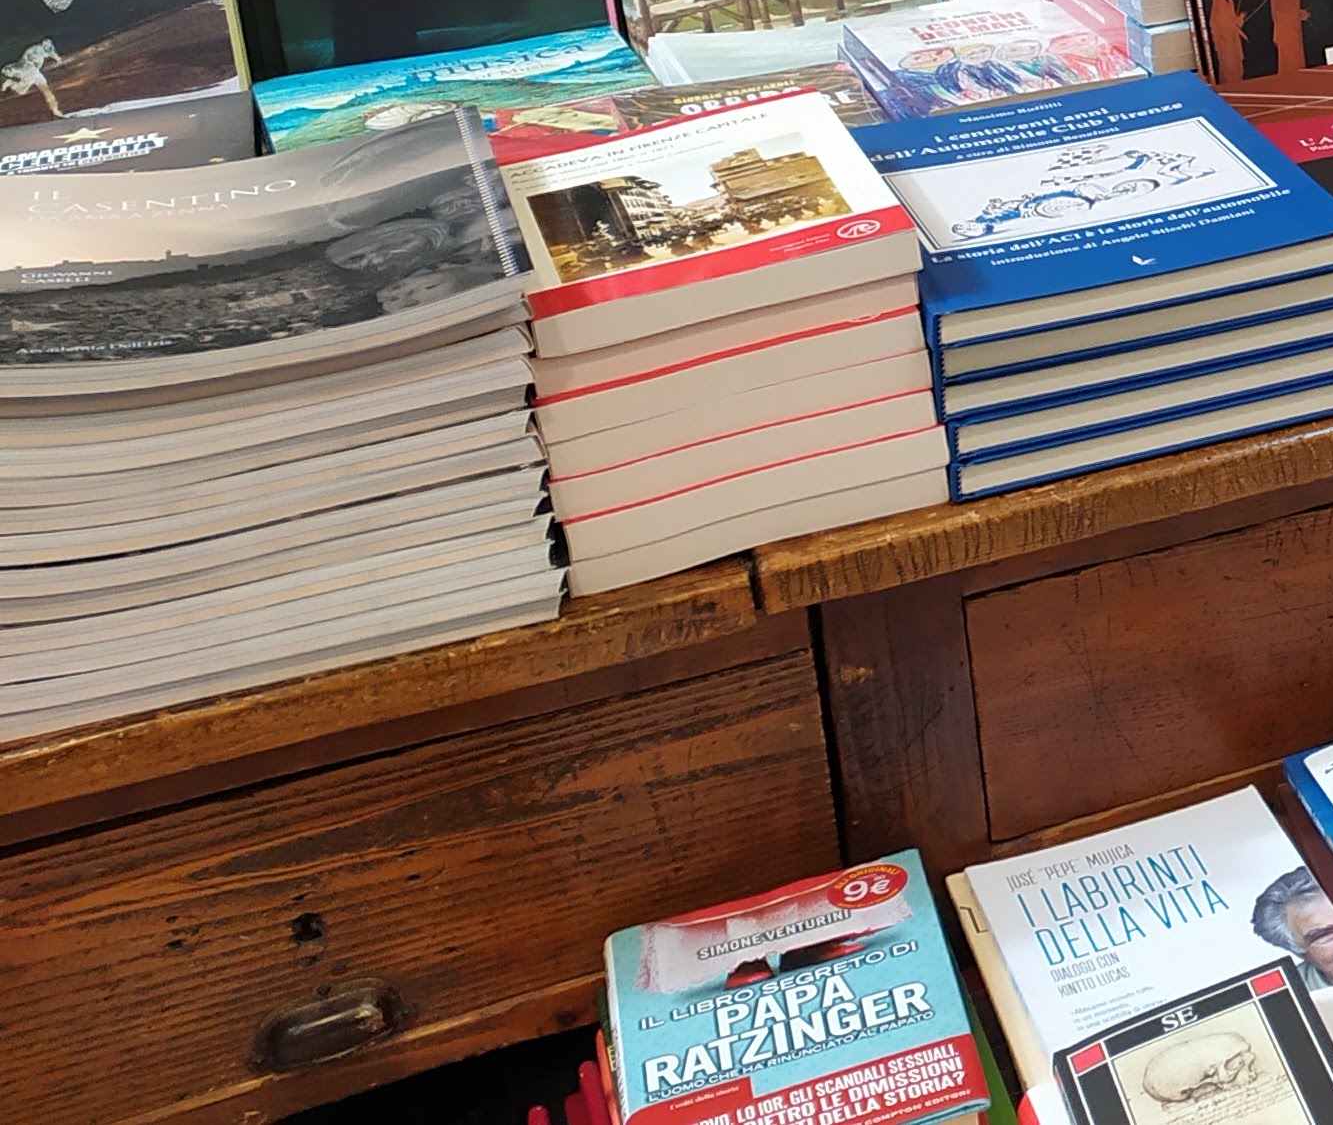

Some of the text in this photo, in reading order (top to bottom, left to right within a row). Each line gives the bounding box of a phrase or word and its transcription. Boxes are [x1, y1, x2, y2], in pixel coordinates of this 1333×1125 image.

[922, 11, 1027, 33] CONFINI
[626, 110, 769, 153] FIRENZE CAPITALE
[868, 99, 1184, 164] dell'Automobile Club Firenze
[946, 106, 1109, 143] centoventi anni
[958, 109, 1014, 125] Massimo
[28, 178, 299, 216] CASENTINO
[957, 188, 1292, 261] storia dell'ACI storia dell'automobile
[991, 208, 1256, 266] introduzione Angelo Damiani
[22, 268, 115, 281] GIOVANNI
[842, 877, 892, 903] 9€
[1006, 843, 1136, 893] JOSÉ MUJICA
[1016, 843, 1209, 928] I LABIRINTI
[697, 909, 852, 961] SIMONE VENTURINI
[1034, 878, 1231, 967] DELLA VITA
[638, 939, 919, 1032] IL LIBRO SEGRETO DI
[1049, 951, 1121, 984] DIALOGO CON
[1058, 965, 1132, 999] KINTTO LUCAS
[715, 975, 856, 1038] PAPA
[1159, 1006, 1199, 1033] SE
[643, 980, 934, 1094] RATZINGER
[708, 1009, 935, 1087] CHE HA RINUNCIATO AL PAPATO
[736, 1042, 960, 1124] LO IOR. GLI SCANDALI SESSUALI.
[821, 1055, 965, 1111] LE DIMISSIONI
[826, 1071, 966, 1125] DELLA STORIA?
